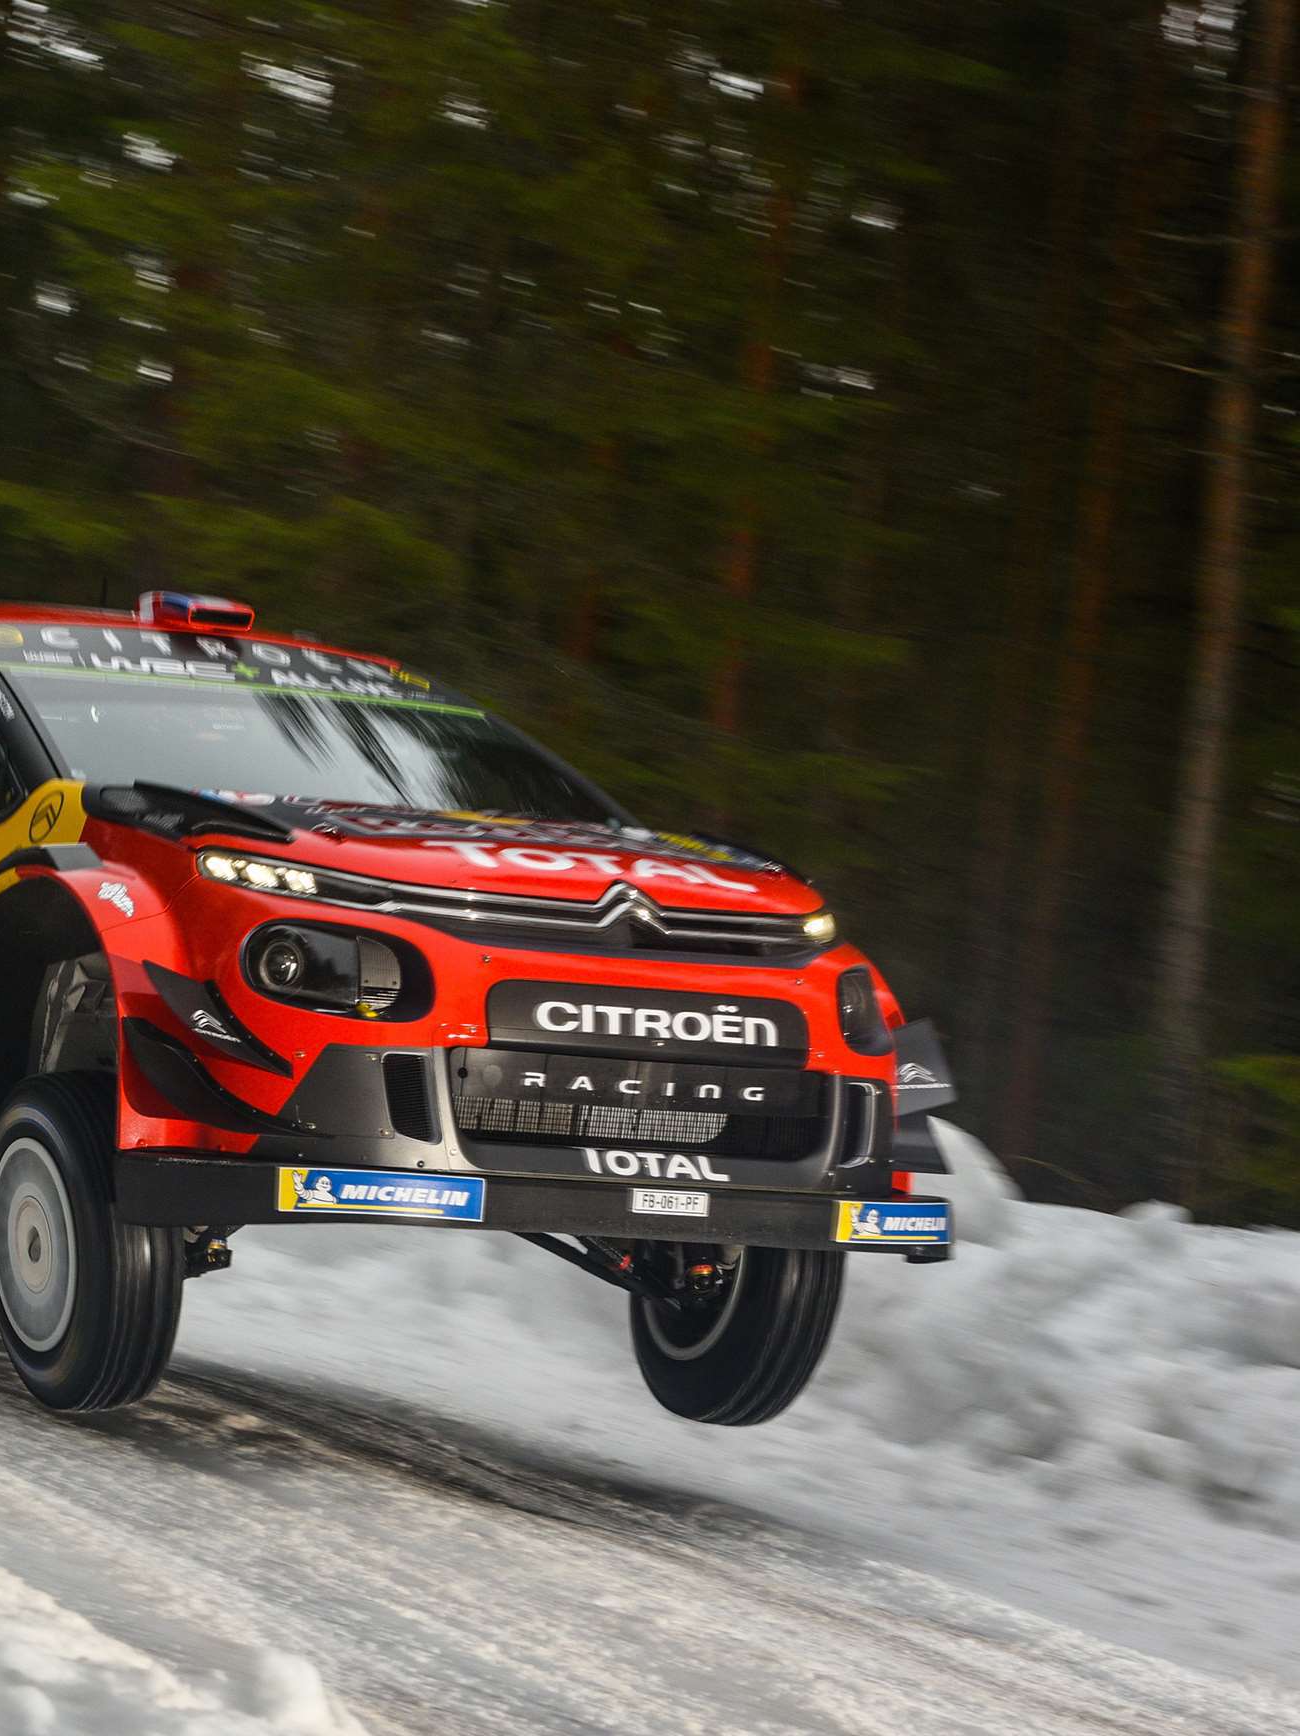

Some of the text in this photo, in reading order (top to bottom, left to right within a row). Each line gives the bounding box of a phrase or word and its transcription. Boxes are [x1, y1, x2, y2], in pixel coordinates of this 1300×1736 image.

[418, 840, 758, 894] TOTAL
[521, 1071, 766, 1102] RACING
[578, 1147, 732, 1182] TOTAL
[340, 1184, 470, 1207] MICHELIN
[882, 1216, 947, 1231] MICHELIN
